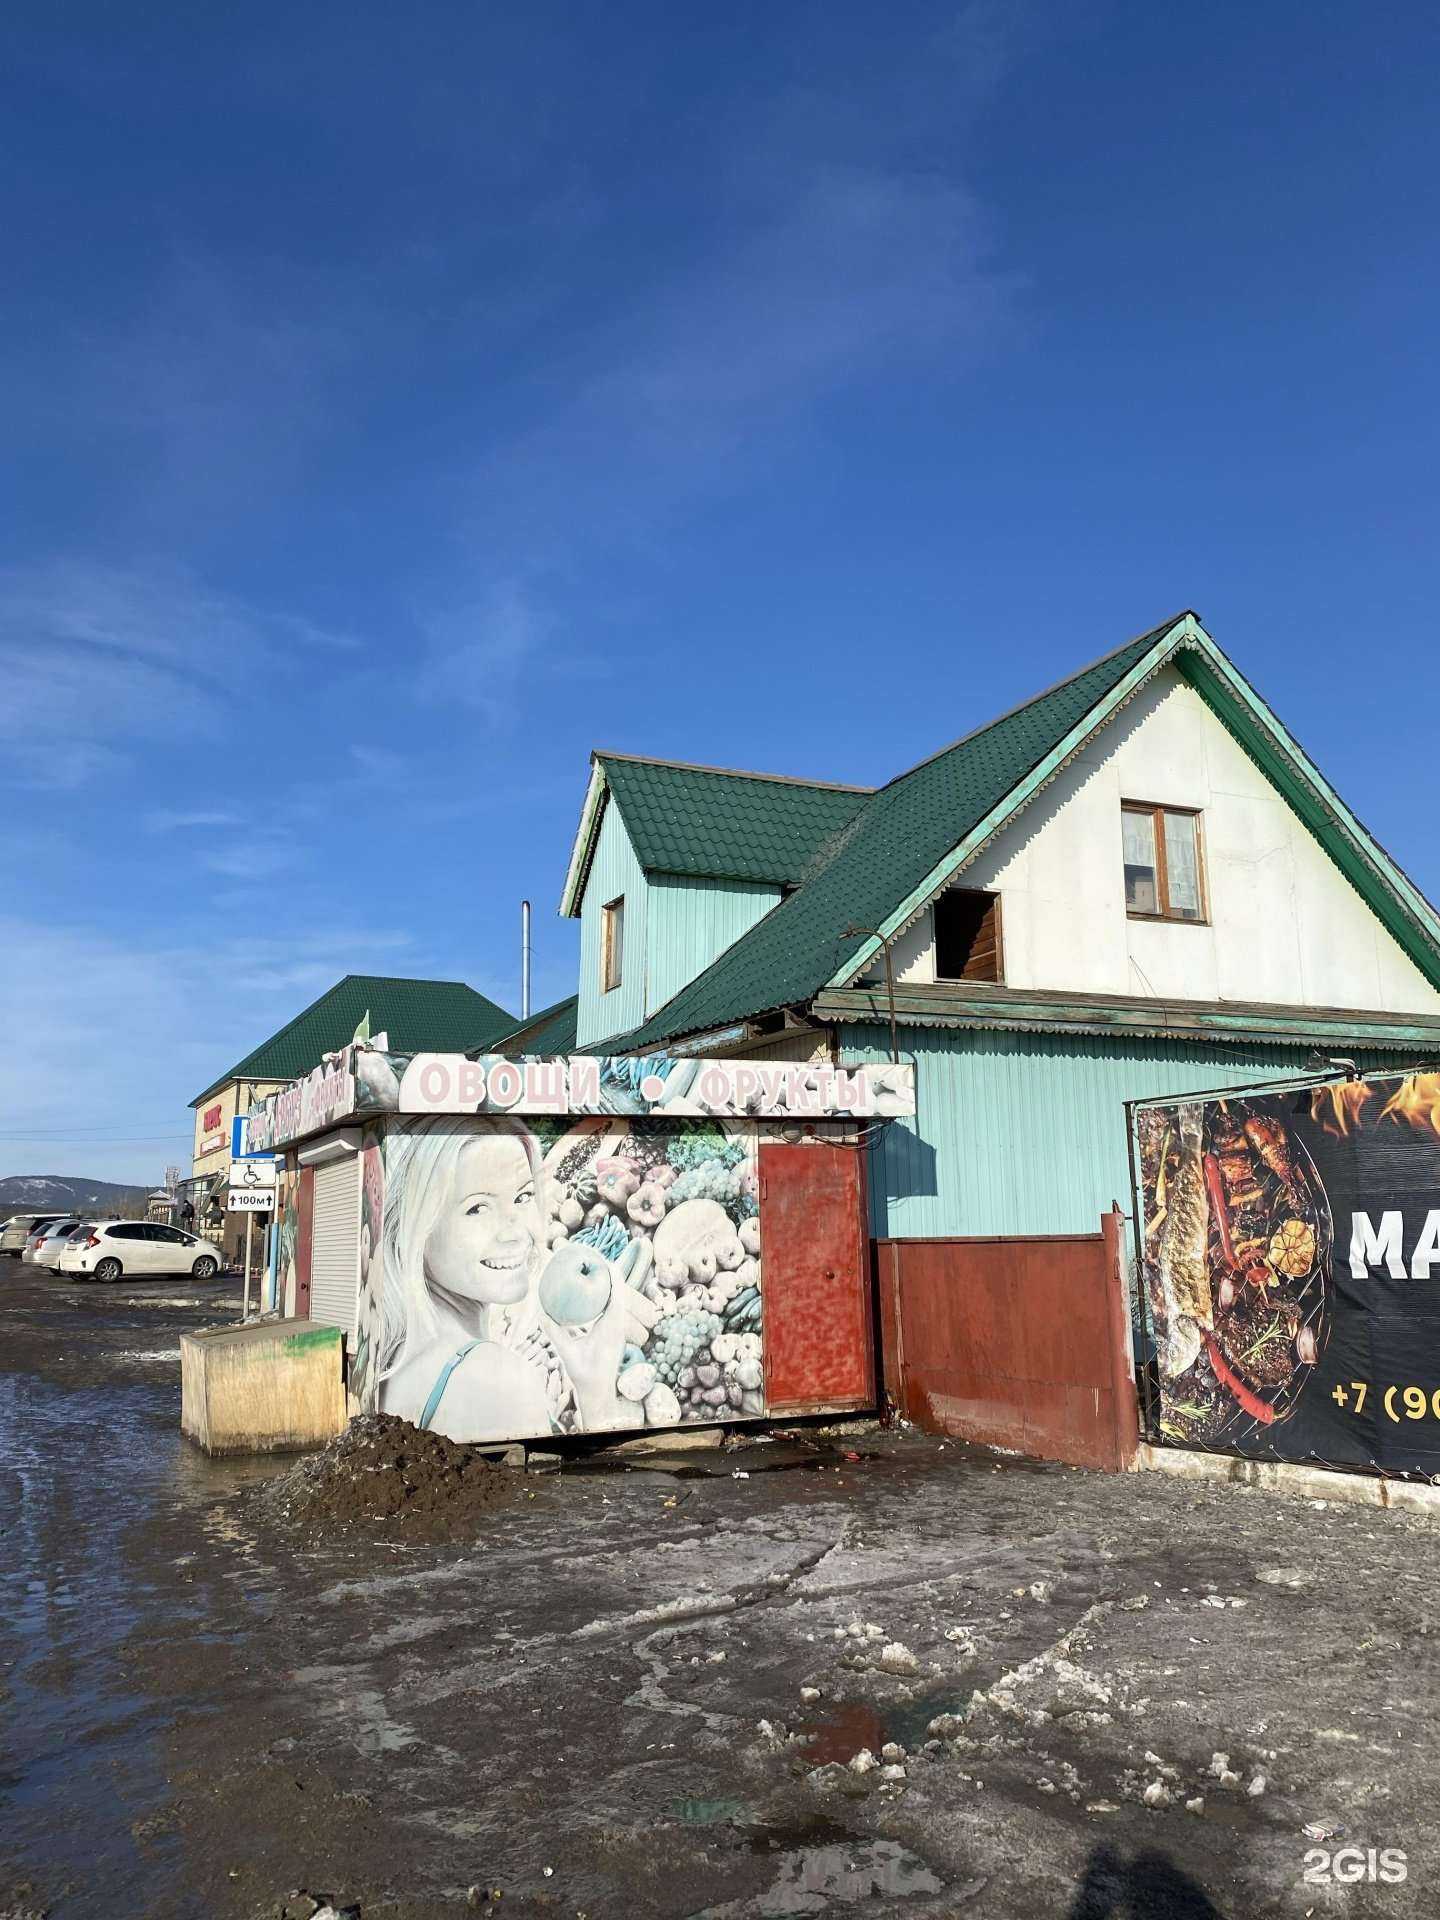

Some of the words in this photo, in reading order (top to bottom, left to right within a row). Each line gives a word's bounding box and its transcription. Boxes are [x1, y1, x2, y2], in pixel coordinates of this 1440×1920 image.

[419, 1062, 600, 1112] ОВОЩИ
[700, 1068, 867, 1108] ФРУКТЫ
[1332, 1383, 1367, 1413] +7
